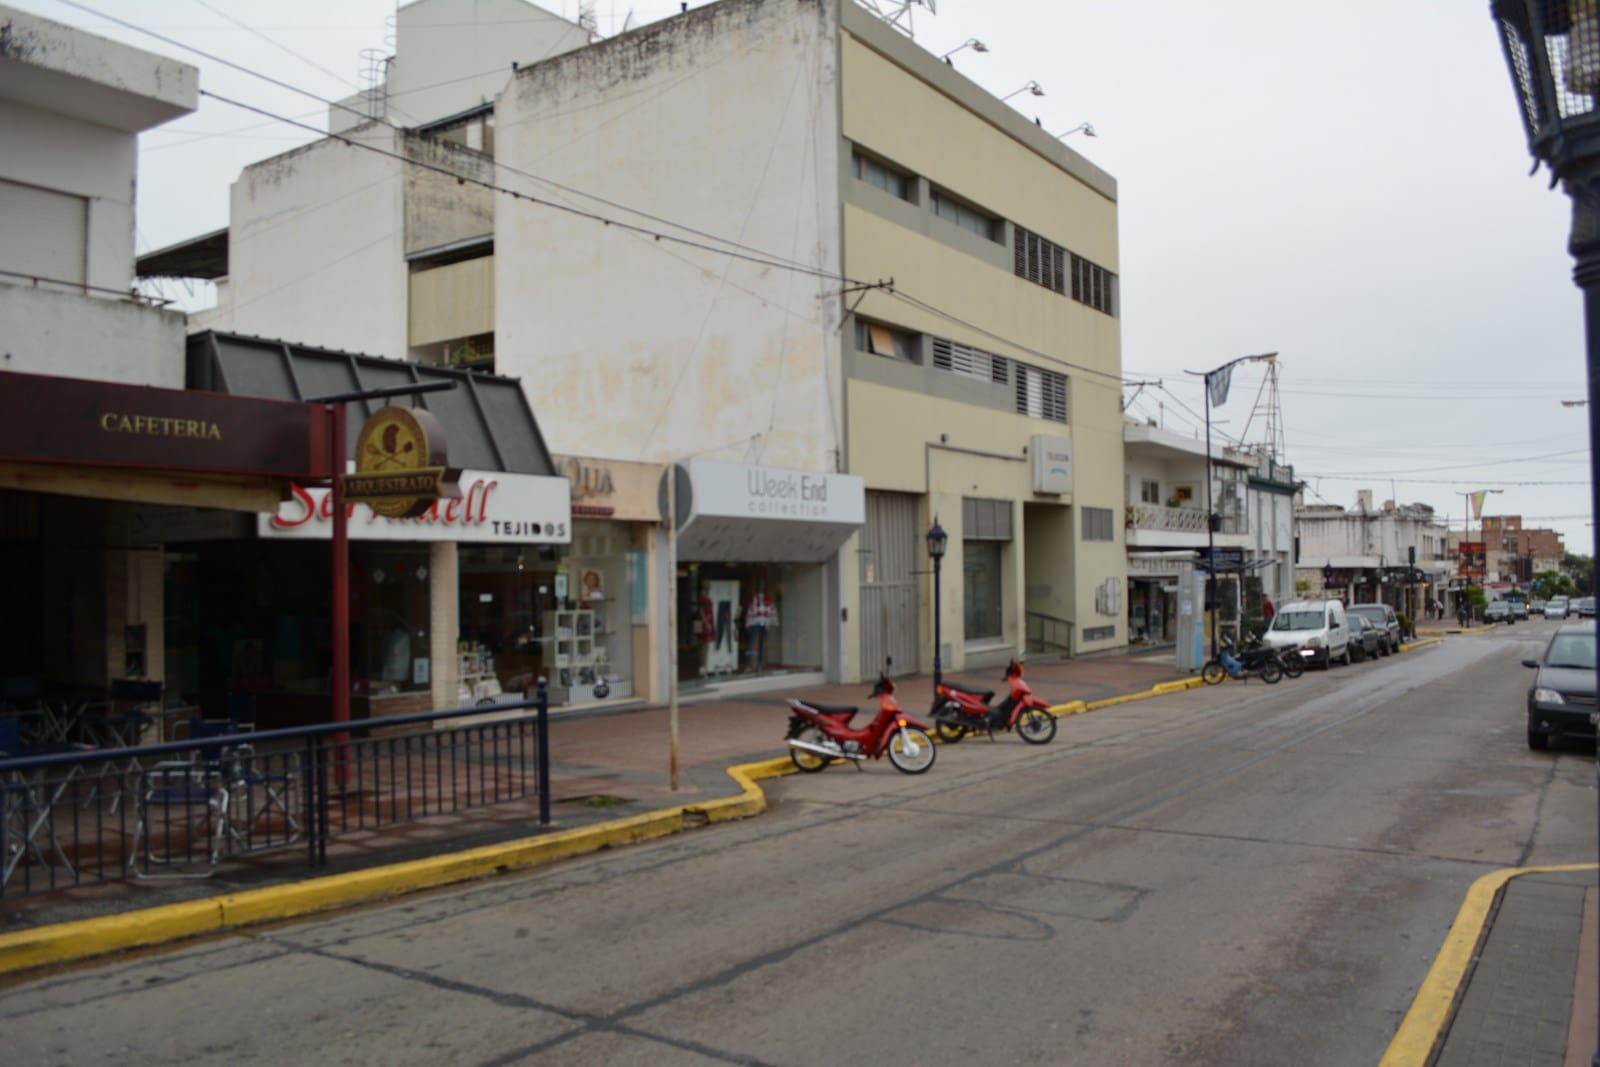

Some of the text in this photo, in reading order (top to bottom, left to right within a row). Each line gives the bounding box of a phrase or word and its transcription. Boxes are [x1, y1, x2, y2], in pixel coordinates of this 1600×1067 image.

[101, 412, 221, 440] CAFETERIA
[747, 468, 828, 501] Week End
[492, 520, 566, 537] TEJIDOS
